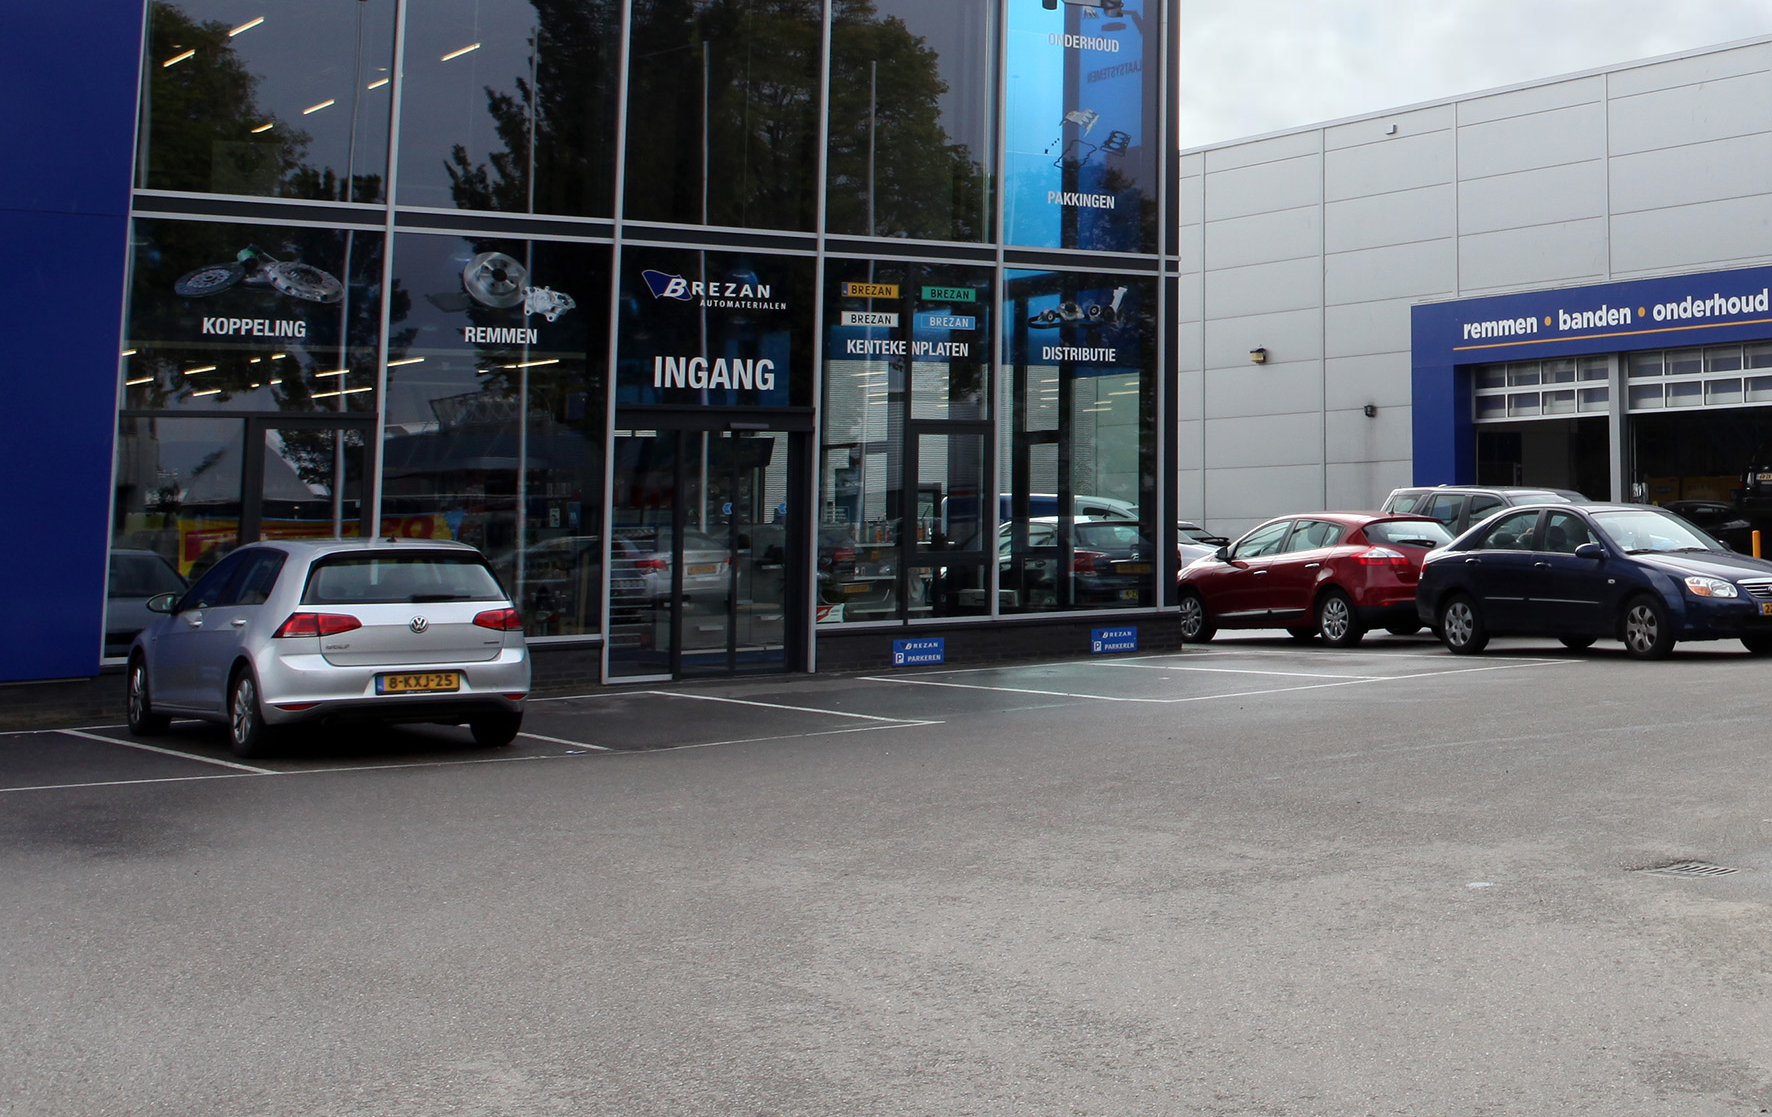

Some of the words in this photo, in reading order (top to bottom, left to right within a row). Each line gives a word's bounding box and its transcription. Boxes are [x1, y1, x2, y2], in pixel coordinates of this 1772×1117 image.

[1047, 32, 1120, 53] ONDERHOUD
[1047, 190, 1115, 210] PAKKINGEN
[663, 278, 771, 298] BREZAN
[851, 285, 892, 296] BREZAN
[930, 289, 969, 299] BREZAN
[700, 299, 787, 310] AUTOMATERIALEN
[851, 314, 892, 324] BREZAN
[1463, 314, 1538, 340] remmen
[1558, 305, 1631, 331] banden
[1652, 288, 1769, 322] onderhoud
[202, 316, 307, 338] KOPPELING
[929, 317, 969, 327] BREZAN
[464, 325, 538, 345] REMMEN
[1042, 346, 1116, 362] DISTRIBUTIE
[653, 355, 775, 390] INGANG
[905, 642, 939, 650] BREZAN
[1104, 642, 1135, 650] PARKEREN
[907, 654, 941, 662] PARKEREN
[389, 674, 453, 689] 8-KXJ-25
